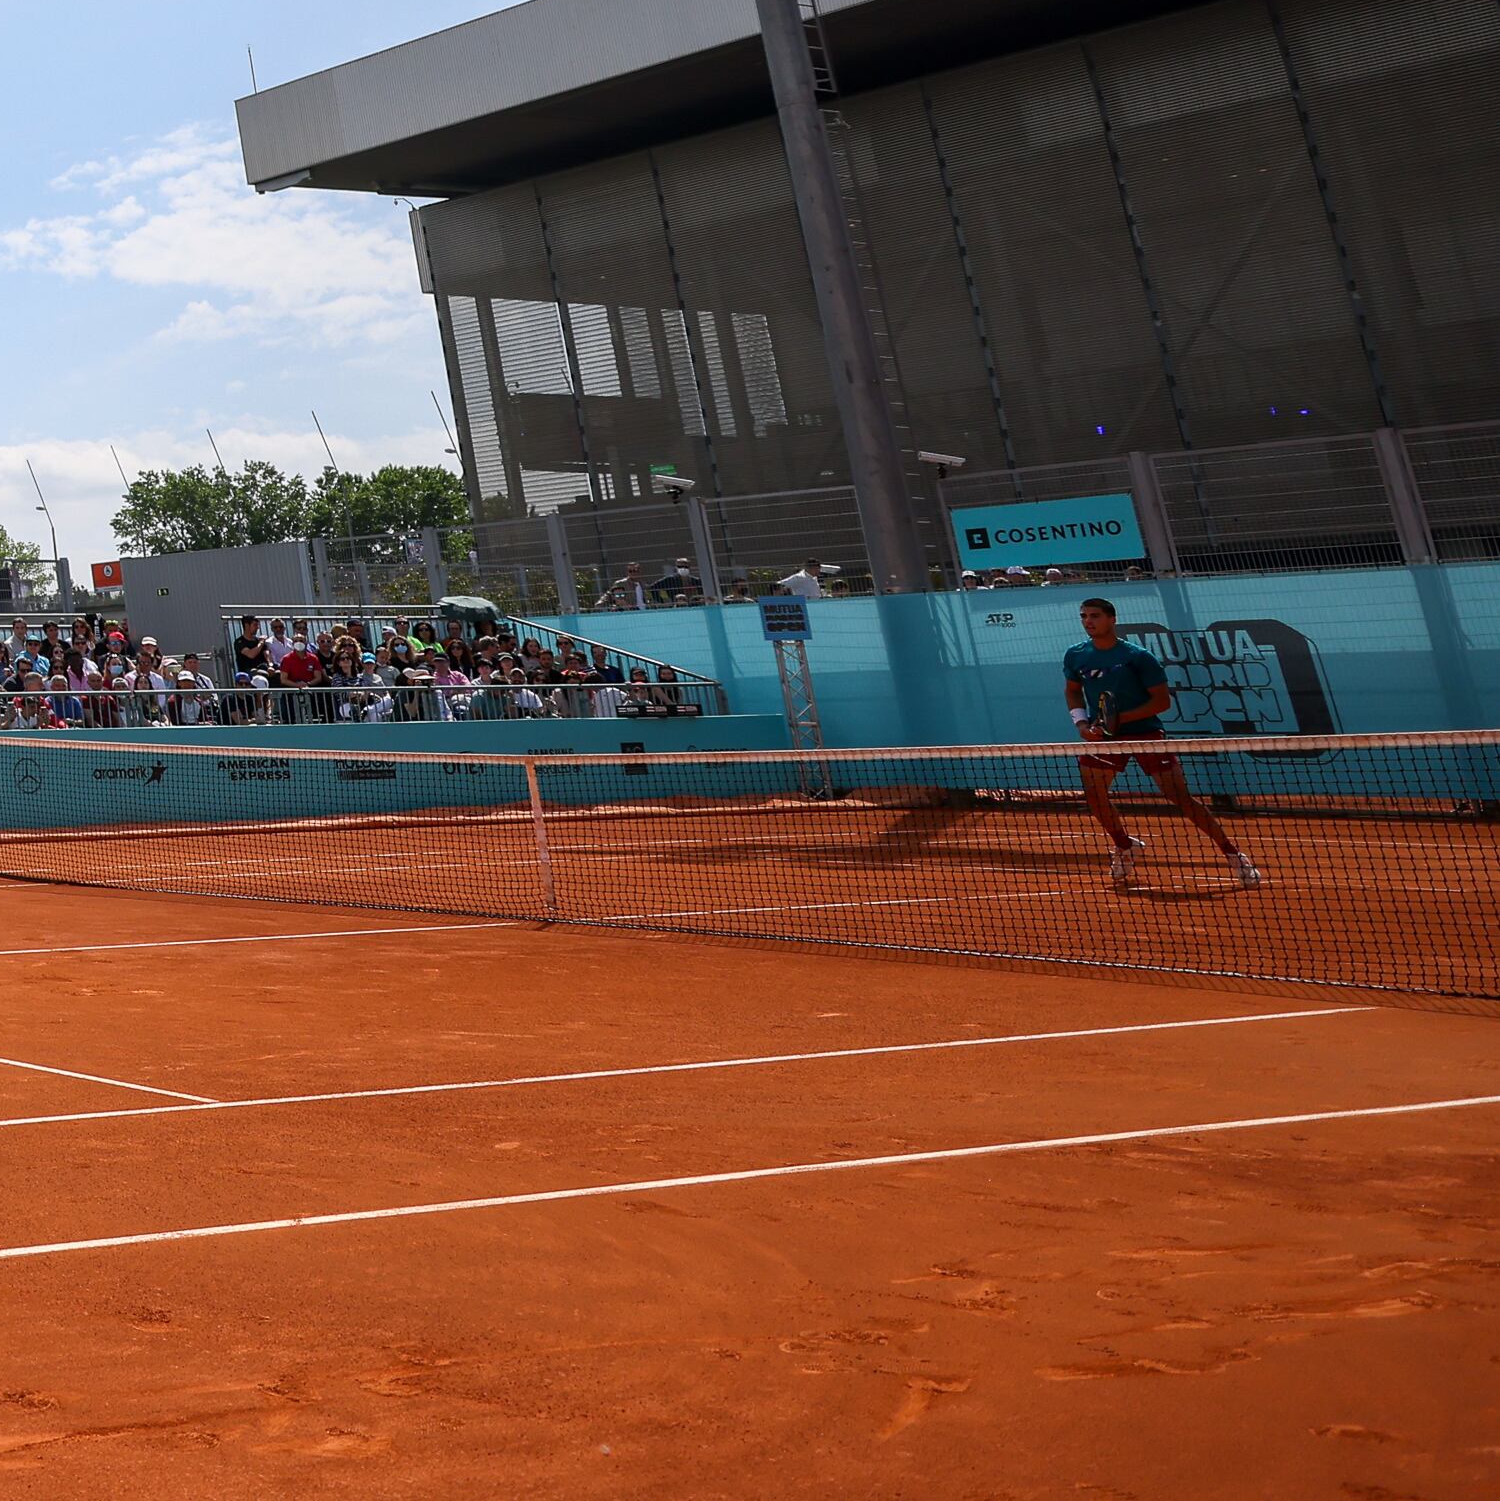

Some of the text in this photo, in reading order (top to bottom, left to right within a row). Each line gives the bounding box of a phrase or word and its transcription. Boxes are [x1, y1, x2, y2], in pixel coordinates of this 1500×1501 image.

[995, 520, 1122, 544] COSENTINO
[985, 613, 1013, 623] ATP
[1126, 630, 1264, 662] MUTUA
[1163, 662, 1273, 688] ADRID
[217, 758, 290, 769] AMERICAN
[93, 765, 147, 780] aramark
[231, 770, 291, 781] EXPRESS
